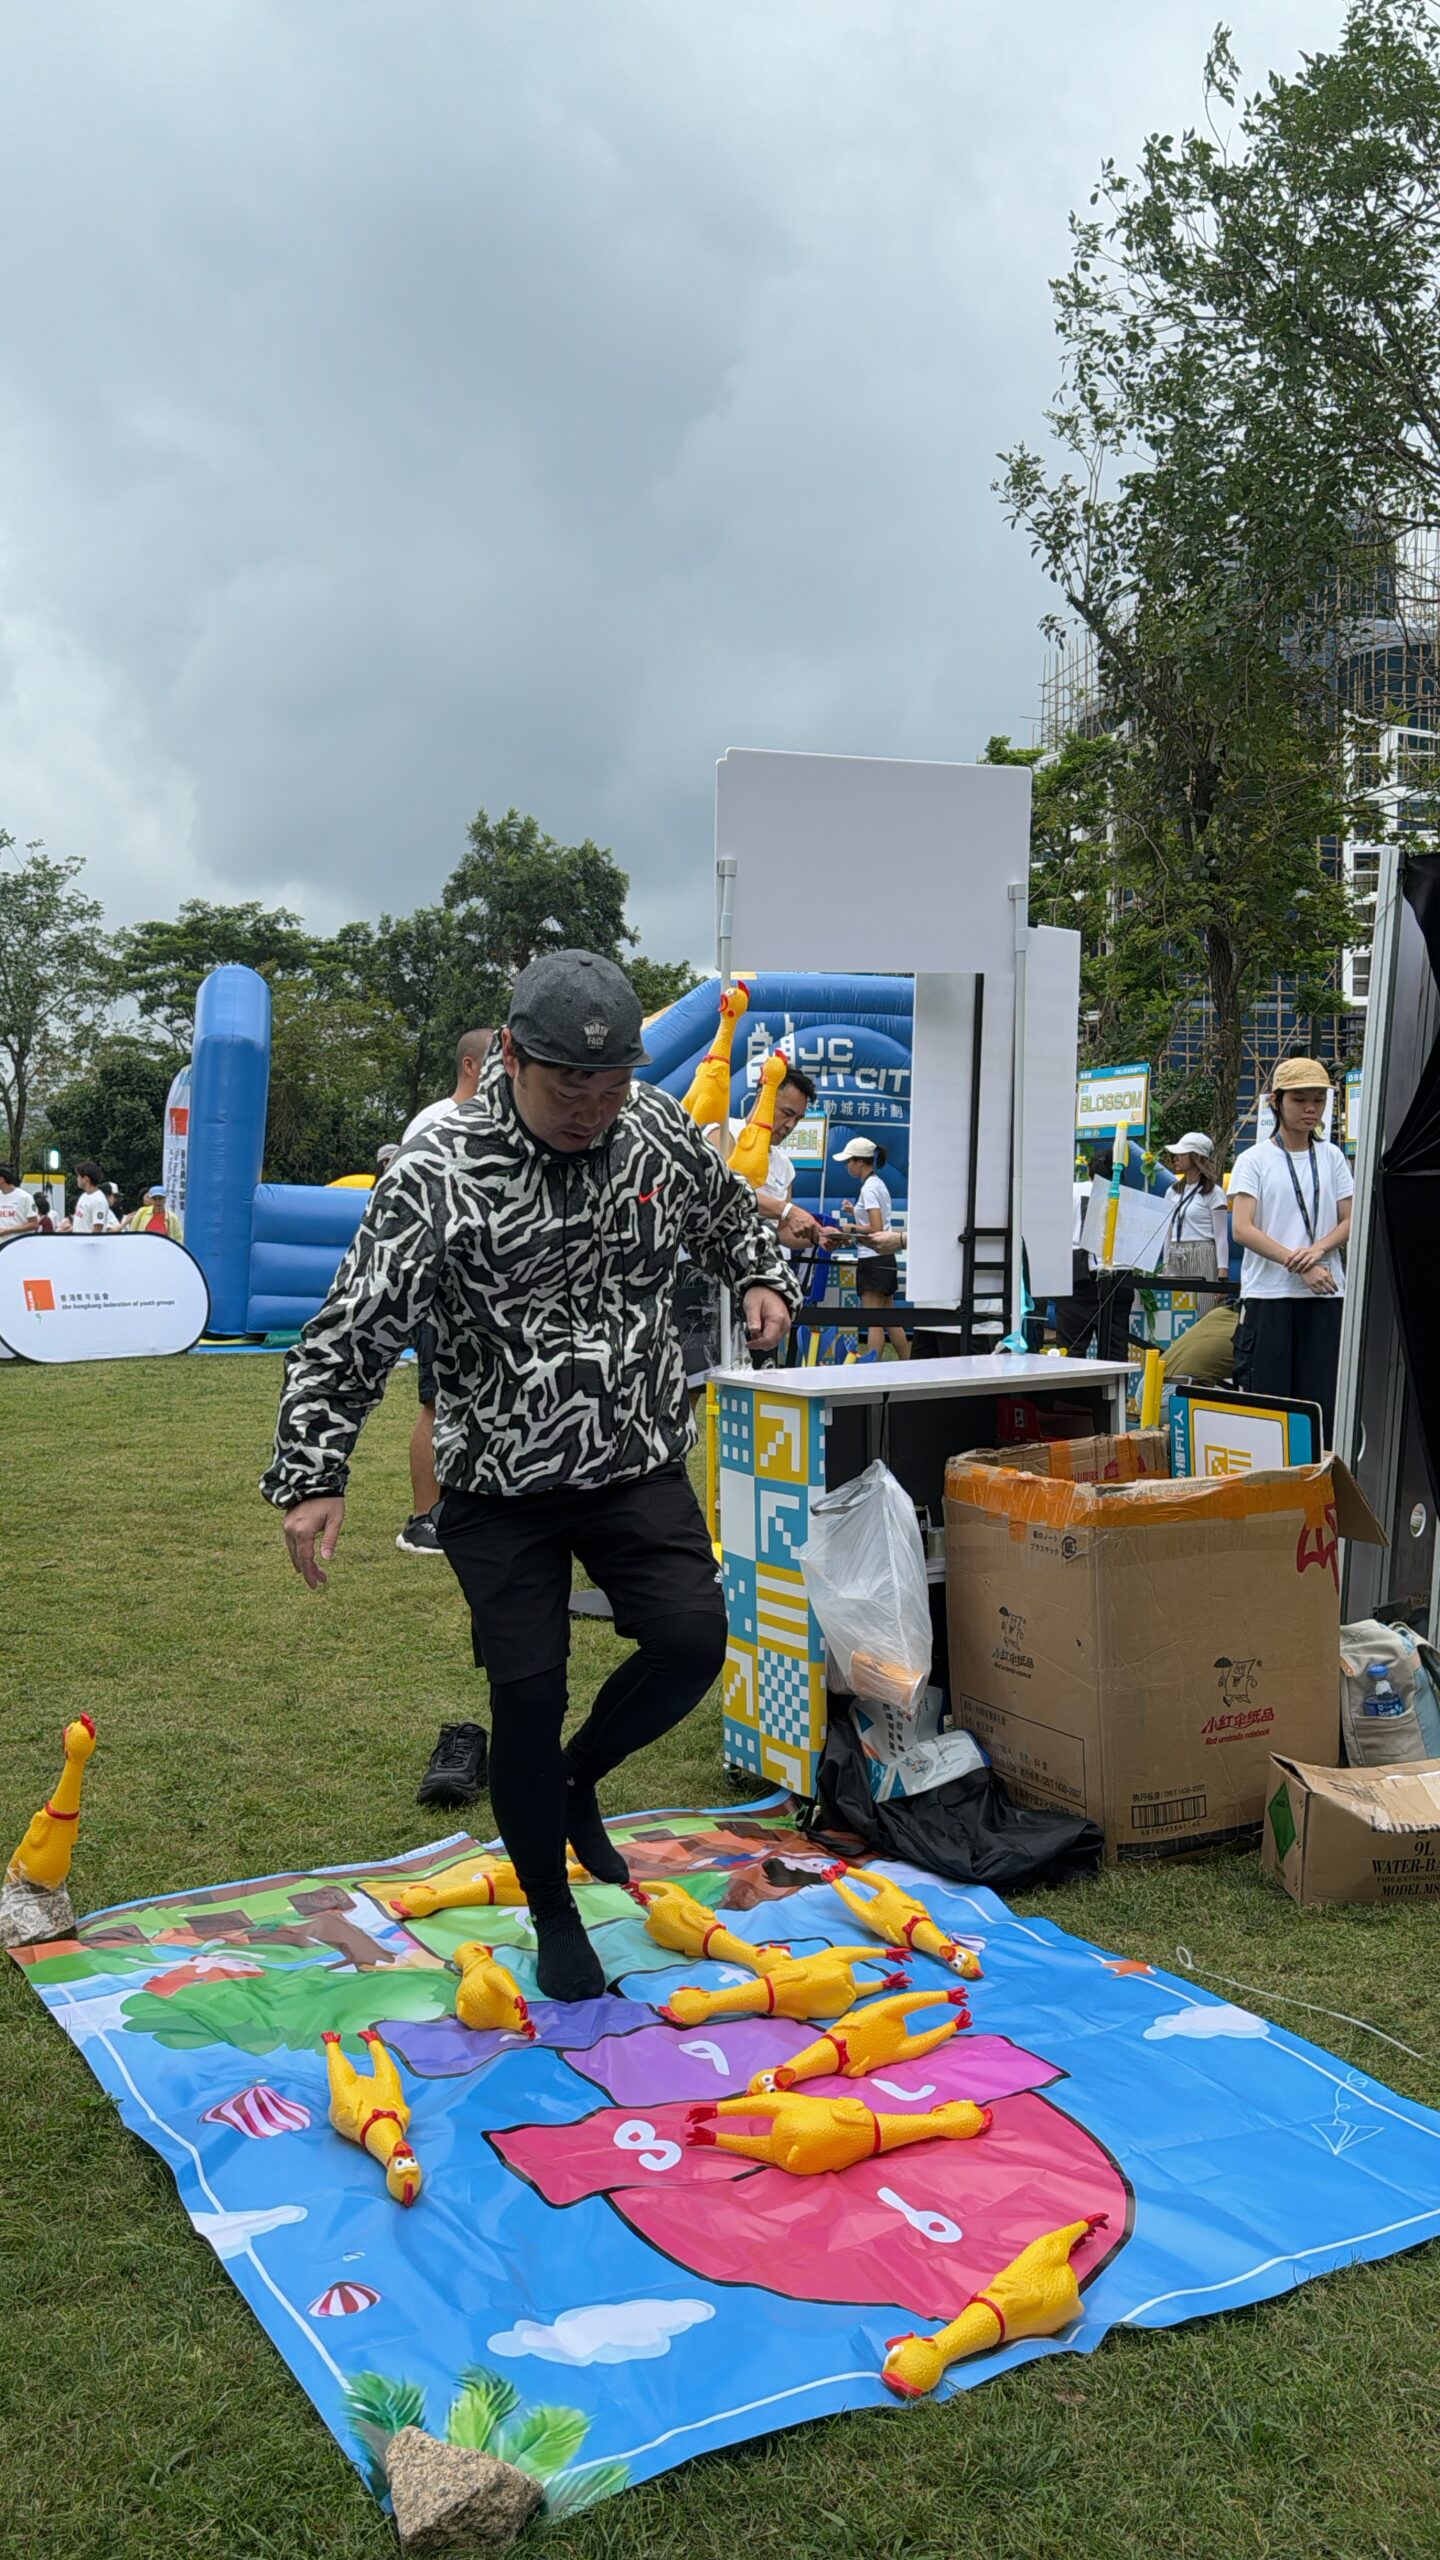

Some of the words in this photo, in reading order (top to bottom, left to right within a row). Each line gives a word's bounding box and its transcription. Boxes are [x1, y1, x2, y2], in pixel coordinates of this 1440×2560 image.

[799, 1037, 854, 1062] JC
[1080, 1090, 1143, 1112] BLOSSOM
[156, 1299, 175, 1307] groups
[1200, 1707, 1275, 1734] 小红伞纸品
[1414, 1841, 1434, 1857] 9L
[1382, 1884, 1421, 1896] MODEL
[613, 2119, 683, 2172] 8
